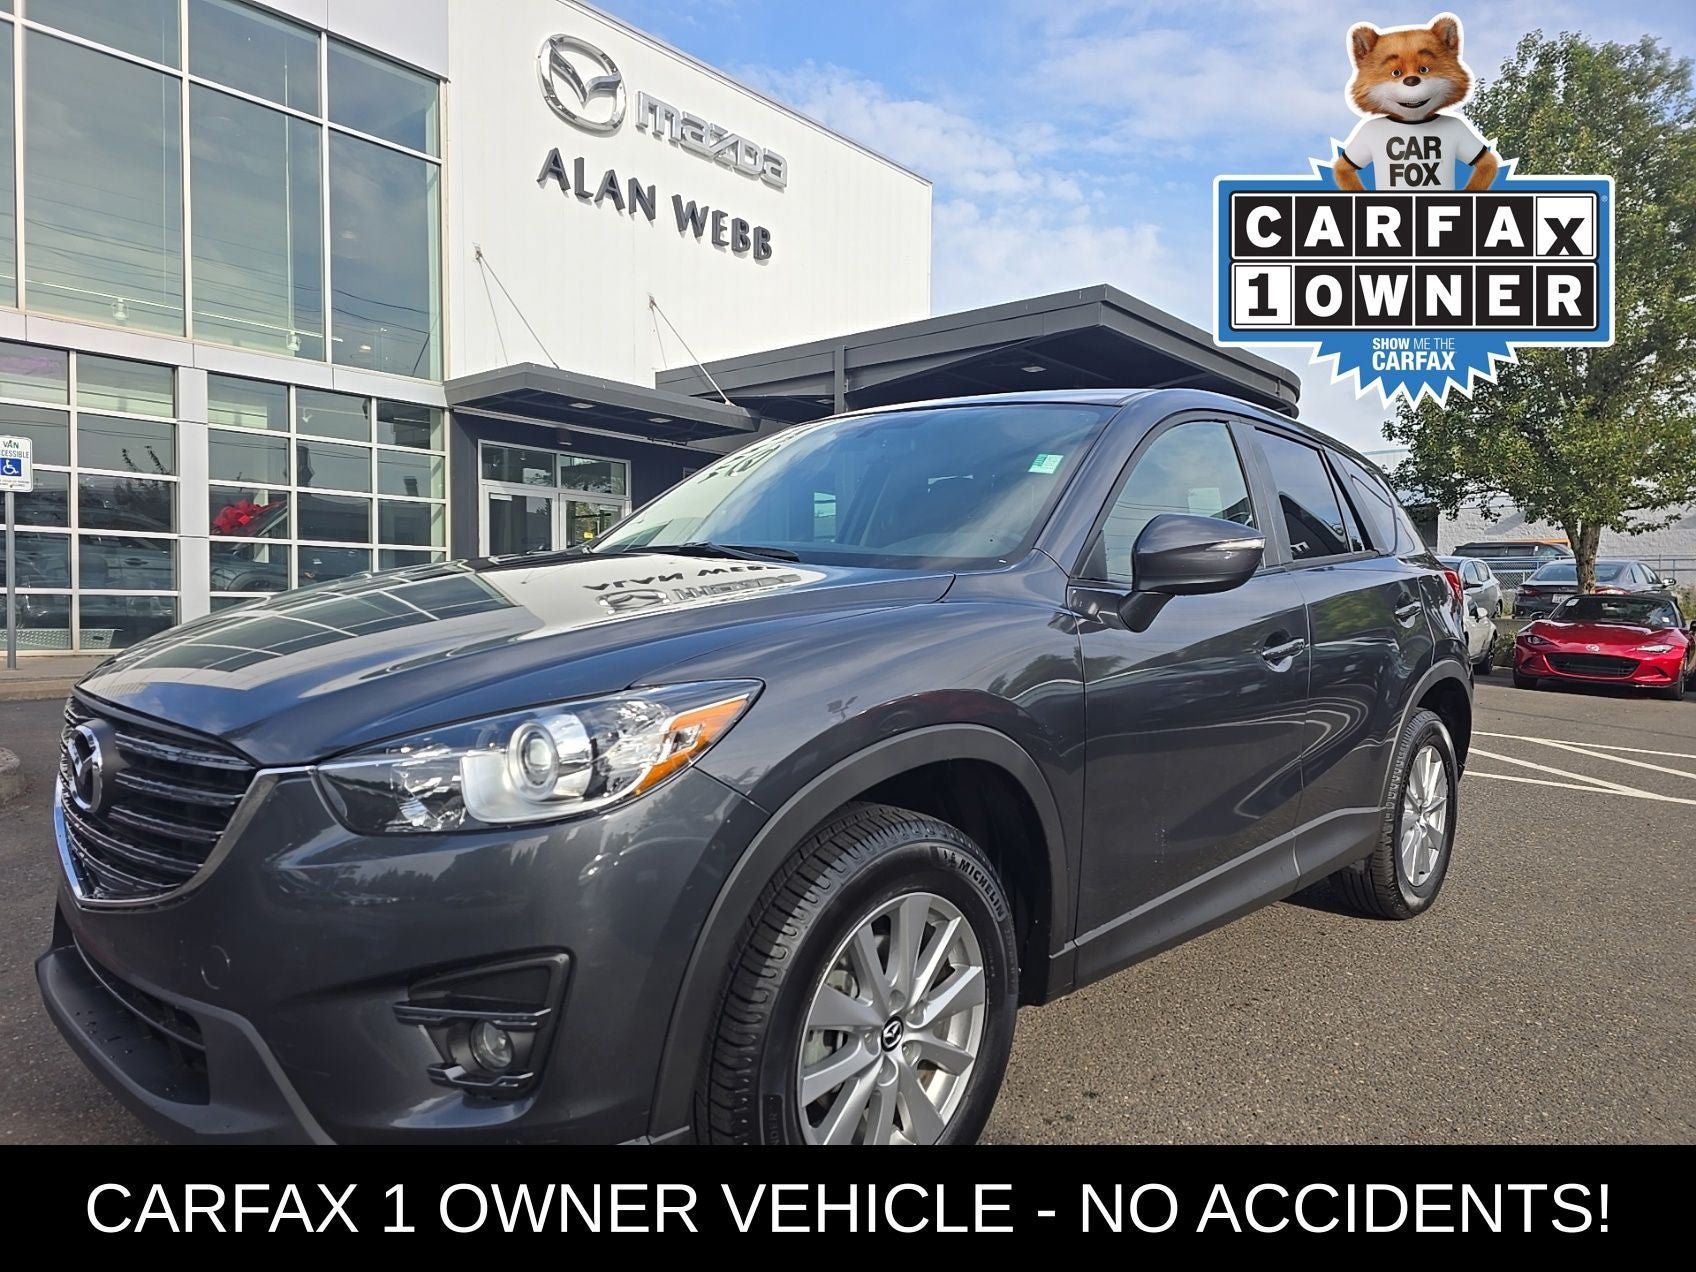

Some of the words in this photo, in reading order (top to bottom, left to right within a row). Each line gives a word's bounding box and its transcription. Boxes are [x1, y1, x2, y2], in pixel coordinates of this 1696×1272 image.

[536, 147, 656, 222] ALAN
[671, 193, 773, 262] WEBB
[3, 440, 19, 449] VAN
[959, 859, 1004, 918] MICHELIN
